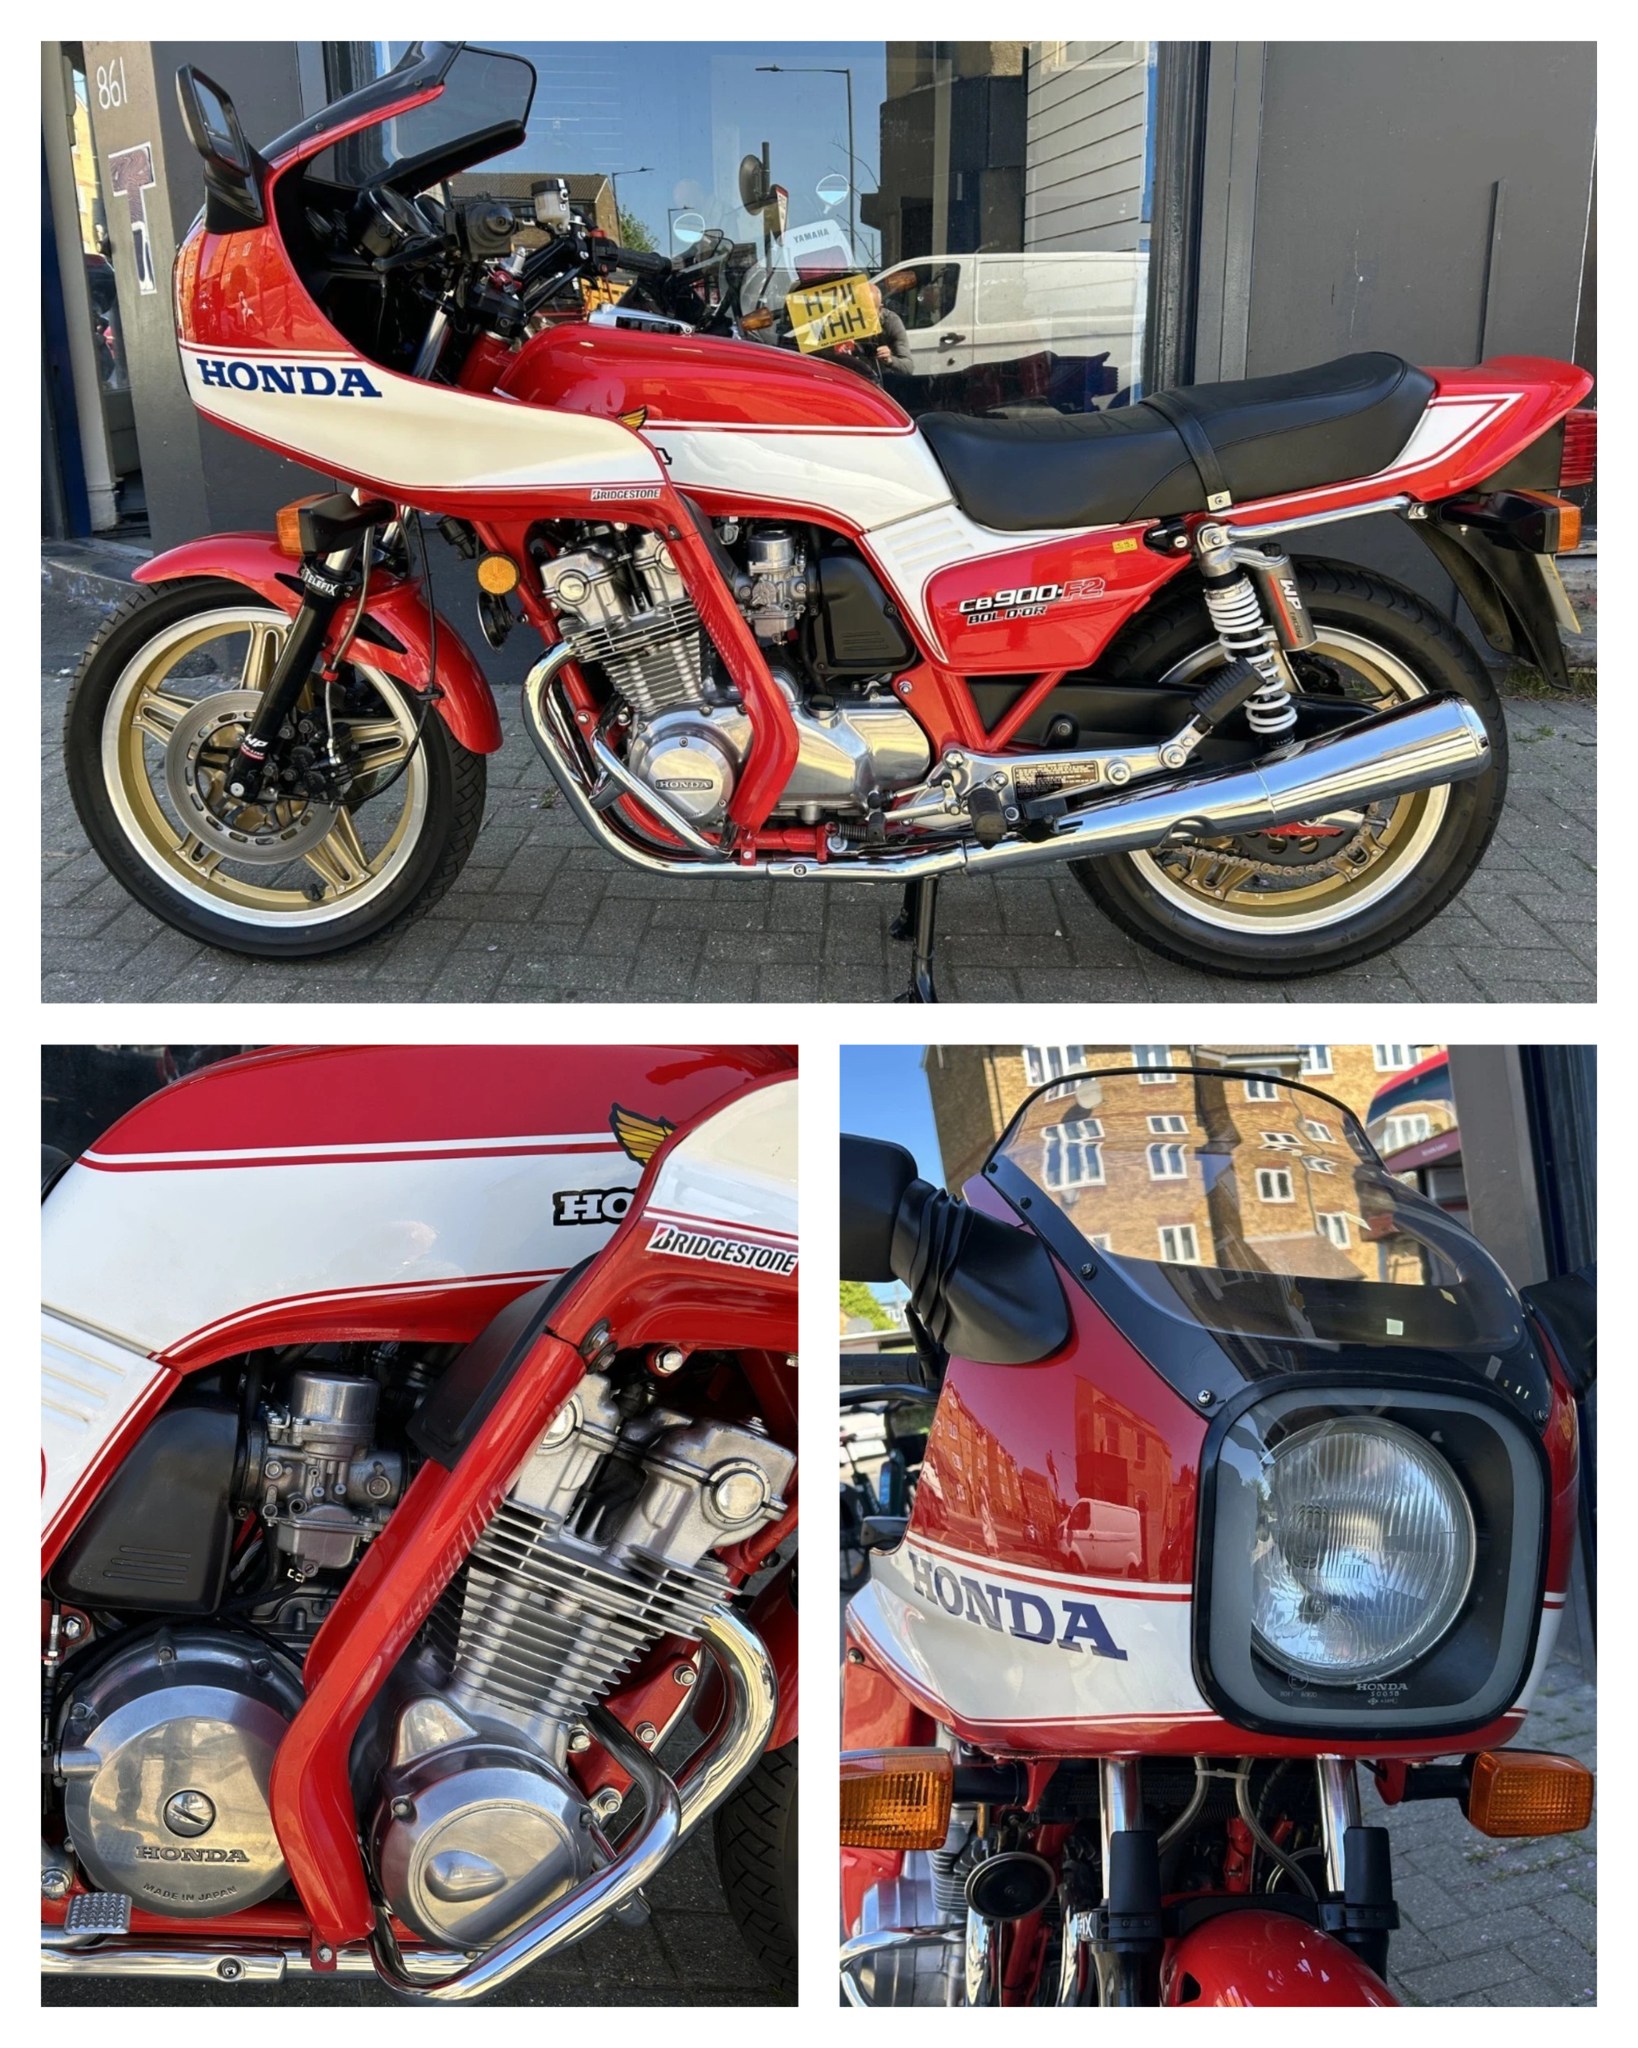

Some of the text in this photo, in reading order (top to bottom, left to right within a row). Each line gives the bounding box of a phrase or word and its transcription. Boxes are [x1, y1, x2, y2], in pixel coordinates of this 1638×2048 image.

[96, 56, 128, 110] 861
[793, 227, 830, 244] YAMAHA
[803, 281, 857, 317] H711
[196, 358, 383, 398] HONDA
[592, 488, 660, 500] BRIDGESTONE
[1279, 579, 1303, 610] WP
[967, 605, 1047, 626] BOL D'OR
[660, 780, 710, 789] HONDA
[650, 1227, 798, 1274] BRIDGESTONE
[908, 1551, 1129, 1662] HONDA
[1355, 1683, 1409, 1692] HONDA
[135, 1845, 251, 1863] HONDA
[143, 1882, 238, 1901] MADE IN JAPAN
